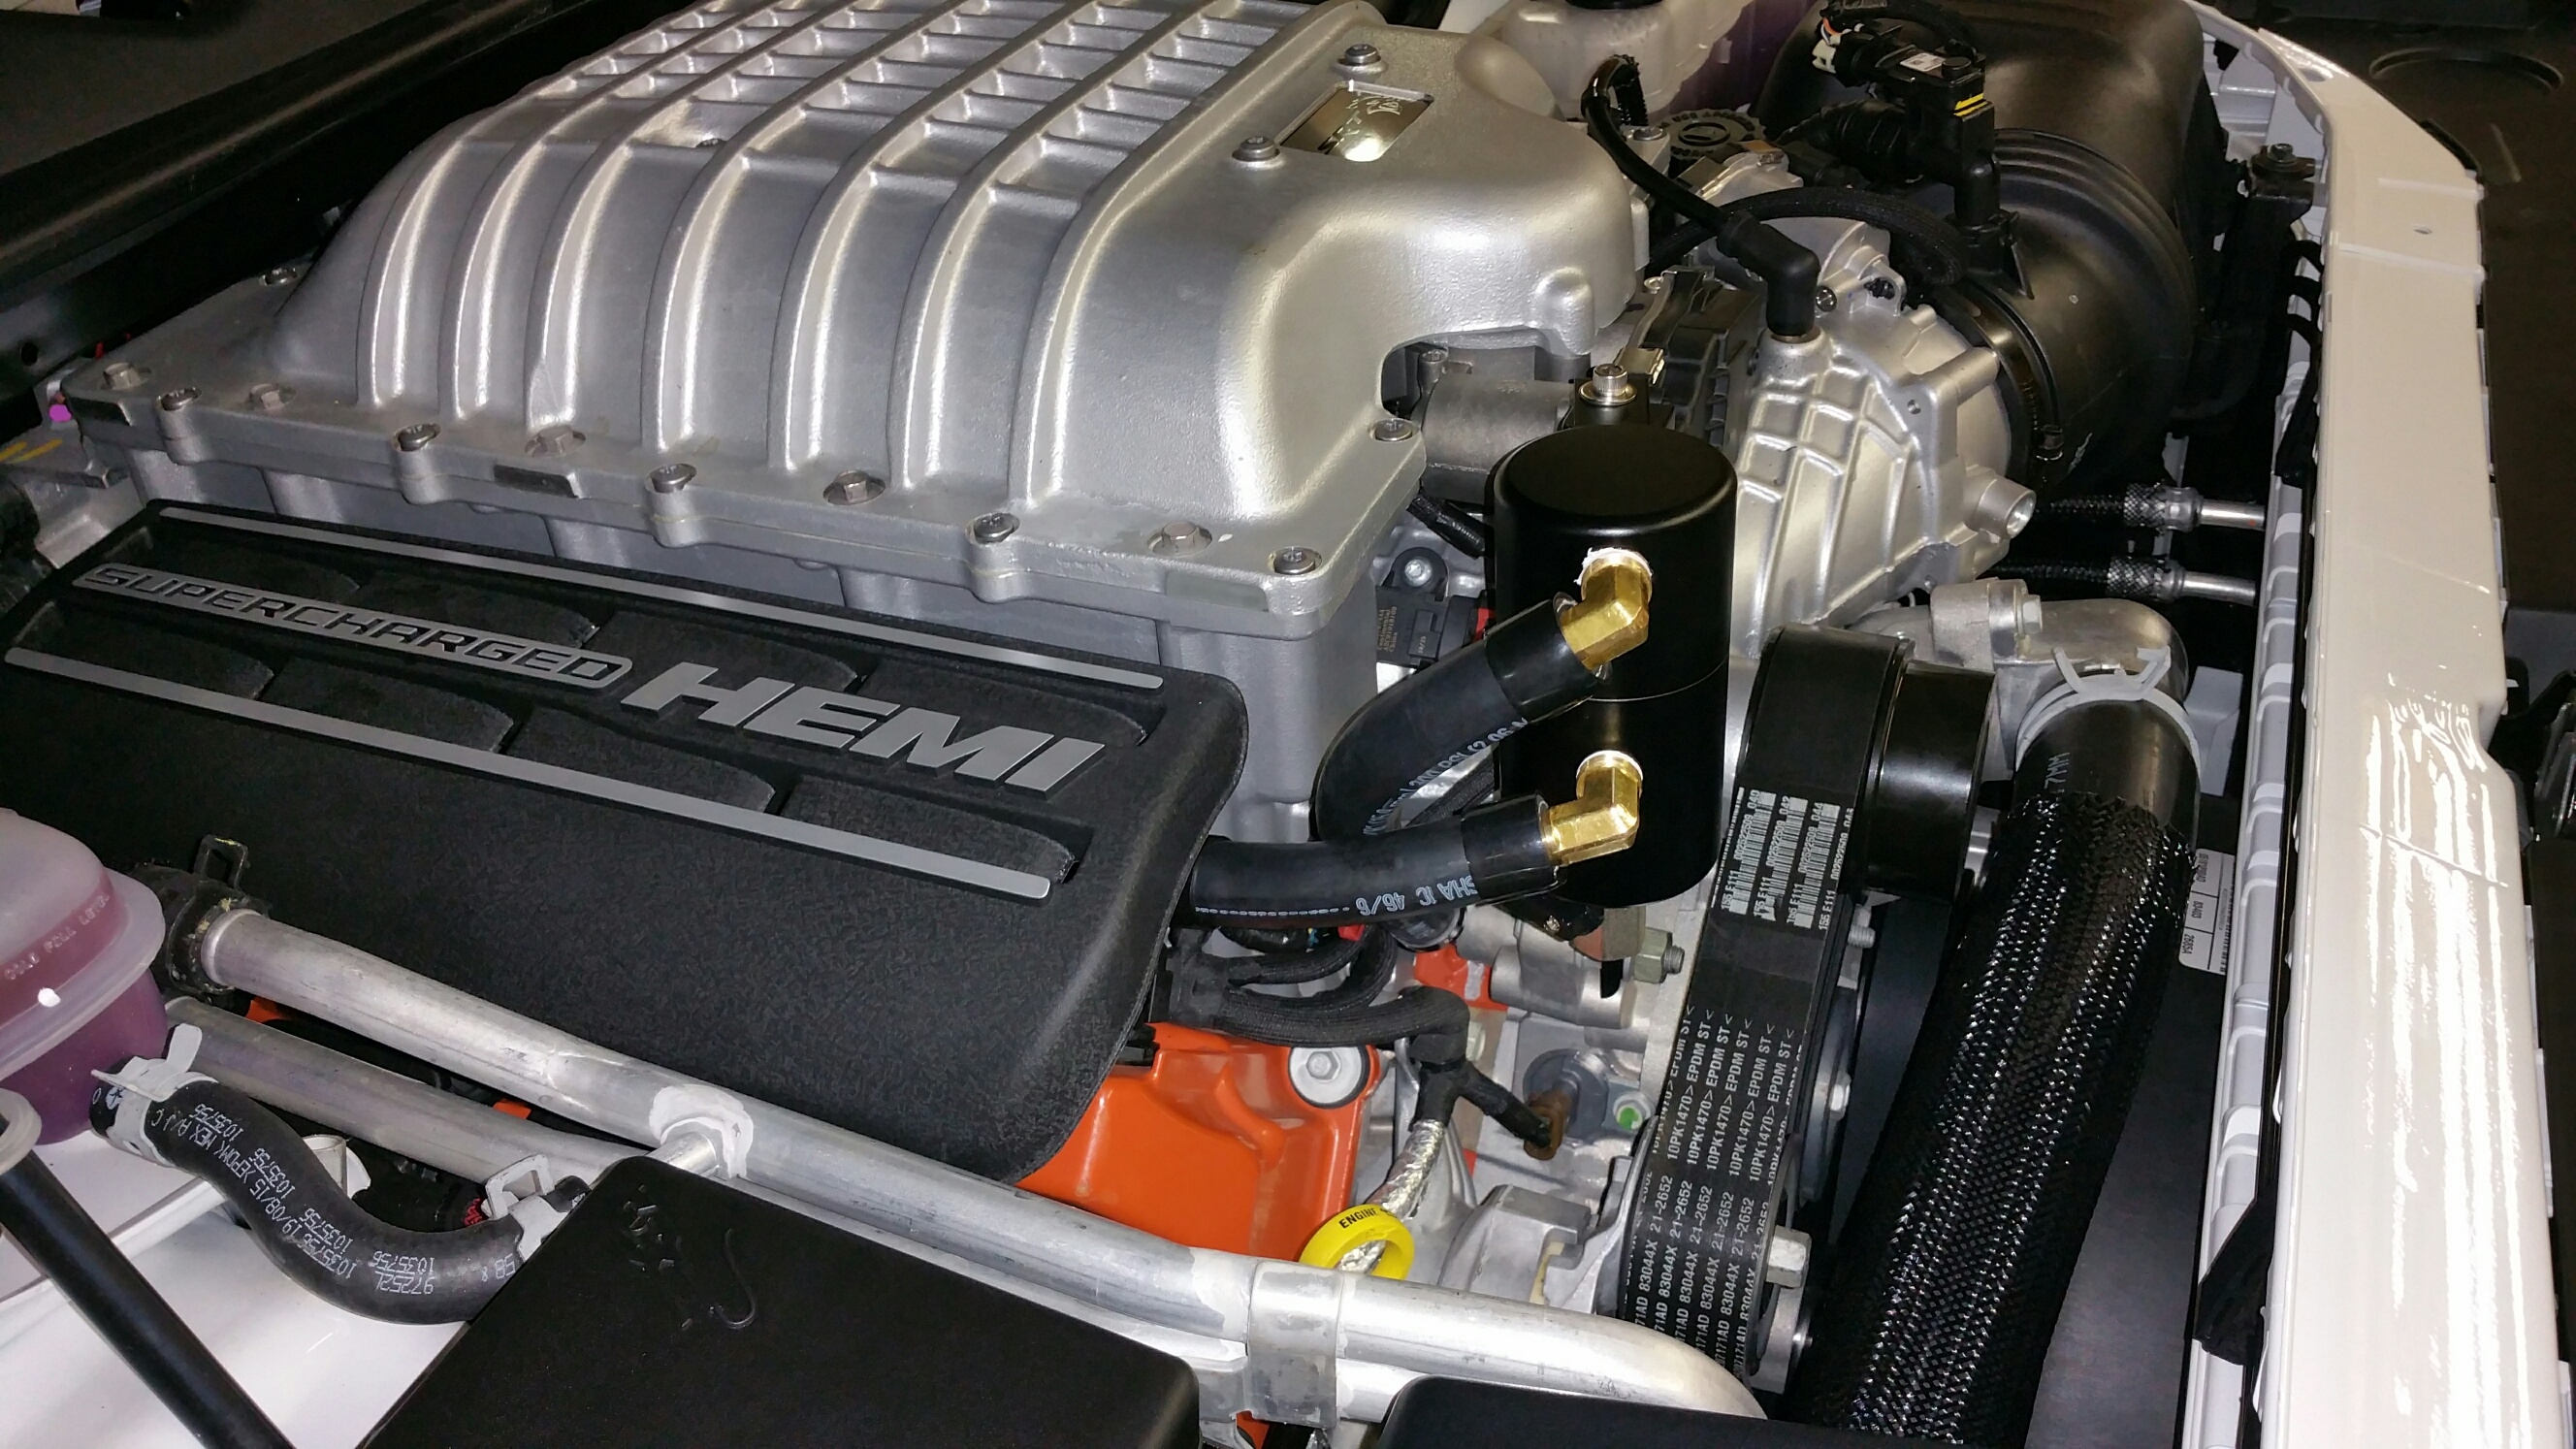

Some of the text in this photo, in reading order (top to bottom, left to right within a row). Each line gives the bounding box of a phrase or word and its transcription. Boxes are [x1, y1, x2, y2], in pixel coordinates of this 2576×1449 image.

[81, 564, 1106, 792] SUPERCHARGED HEMI
[1356, 892, 1404, 915] 46/6
[188, 1123, 218, 1148] MEX
[193, 1101, 243, 1141] 1035756
[248, 1145, 297, 1198] 1035756
[249, 1176, 304, 1238] 19/08/15
[302, 1207, 354, 1254] 1035756
[1638, 1239, 1658, 1292] 83044X
[1650, 1175, 1673, 1233] 21-2652
[296, 1233, 359, 1279] 1035756
[371, 1251, 435, 1274] 1035756
[1658, 1244, 1678, 1298] 83044X
[1669, 1180, 1693, 1239] 21-2652
[1679, 1251, 1699, 1304] 83044X
[1690, 1185, 1713, 1244] 21-2652
[1700, 1257, 1721, 1310] 83044X
[1711, 1191, 1735, 1251] 21-2652
[1721, 1263, 1739, 1315] 83044X
[1731, 1197, 1755, 1256] 21-2652
[375, 1271, 435, 1295] 97252L
